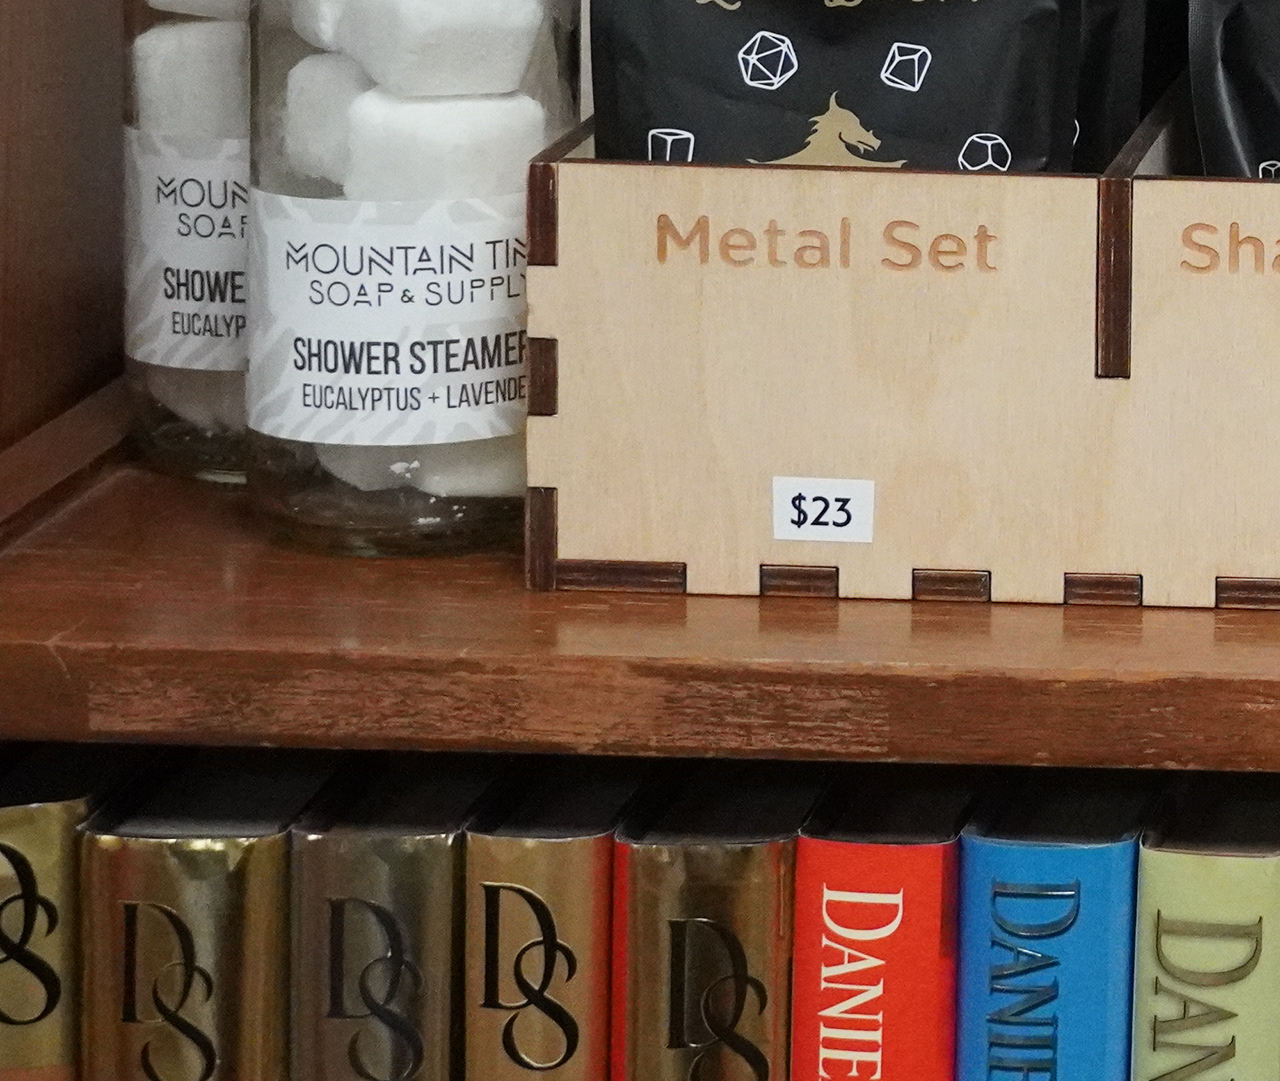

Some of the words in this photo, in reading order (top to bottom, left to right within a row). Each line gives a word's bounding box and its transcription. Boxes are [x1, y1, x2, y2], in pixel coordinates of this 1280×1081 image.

[286, 241, 474, 276] MOUNTAIN
[656, 214, 850, 269] Metal
[881, 220, 998, 272] Set
[309, 280, 394, 307] SOAP
[401, 289, 415, 303] &
[425, 274, 527, 306] SUPPL
[293, 337, 400, 375] SHOWER
[303, 383, 421, 411] EUCALYPTUS
[428, 392, 440, 403] +
[790, 493, 852, 528] $23
[817, 882, 904, 1081] DANIE
